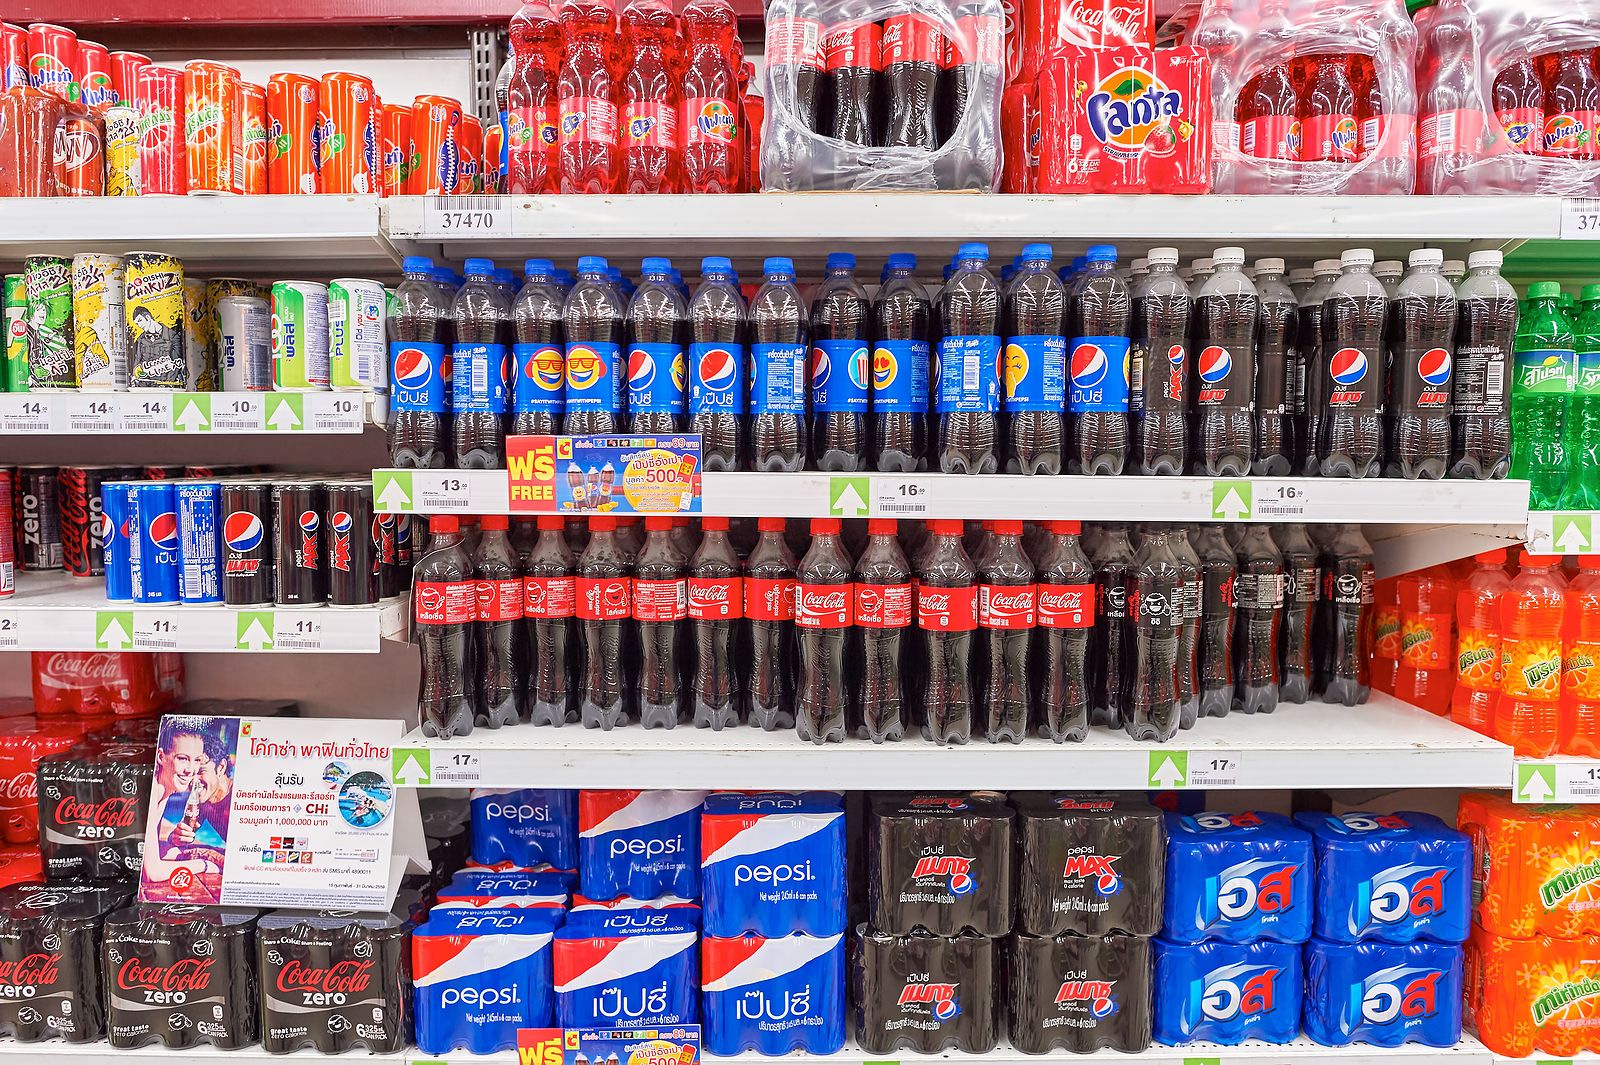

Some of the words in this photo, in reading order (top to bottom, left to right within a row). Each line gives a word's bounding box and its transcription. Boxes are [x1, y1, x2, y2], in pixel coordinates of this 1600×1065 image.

[1088, 86, 1181, 142] Fanta
[441, 213, 494, 229] 37470
[671, 437, 685, 448] 89
[507, 445, 555, 482] ฟรี
[511, 485, 554, 500] FREE
[23, 495, 40, 545] zero
[303, 531, 319, 570] MAX
[335, 531, 351, 572] MAX
[690, 584, 729, 602] Coca-Cola
[803, 591, 847, 609] Coca-Cola
[919, 594, 951, 610] ca-Cola
[991, 591, 1034, 609] Coca-Cola
[1039, 591, 1083, 609] Coca-Cola
[47, 652, 120, 679] Coca-Cola
[249, 737, 296, 758] โค้กซ่า
[300, 738, 390, 760] พาฟินทั่วไทย
[453, 754, 471, 766] 17
[1211, 759, 1229, 771] 17
[274, 772, 305, 789] ลุ้นรับ
[54, 795, 140, 827] Coca-Cola
[305, 803, 329, 815] CHi
[486, 801, 550, 823] pepsi
[239, 816, 273, 828] รวมมูลค่า
[275, 817, 311, 827] 1,000,000
[314, 818, 329, 827] บาท
[77, 825, 115, 838] zero
[610, 834, 682, 859] pepsi
[1067, 846, 1095, 856] pepsi
[734, 859, 812, 887] pepsi
[1063, 855, 1122, 878] MAX
[1540, 858, 1600, 909] mirind
[1204, 863, 1302, 930] เอส
[1355, 867, 1456, 936] เอส
[118, 933, 139, 943] Coke
[280, 936, 301, 945] Coke
[117, 957, 217, 992] Coca-Cola
[276, 959, 376, 993] Coca-Cola
[143, 990, 187, 1004] zero
[303, 992, 347, 1005] zero
[441, 983, 517, 1009] pepsi
[593, 981, 668, 1017] เป๊ปซี่
[736, 984, 811, 1020] เป๊ปซี่
[1188, 967, 1287, 1036] เอส
[1346, 970, 1450, 1037] เอส
[197, 1020, 208, 1035] 6
[270, 1028, 290, 1036] great
[355, 1023, 366, 1037] 6
[671, 1028, 686, 1039] 89
